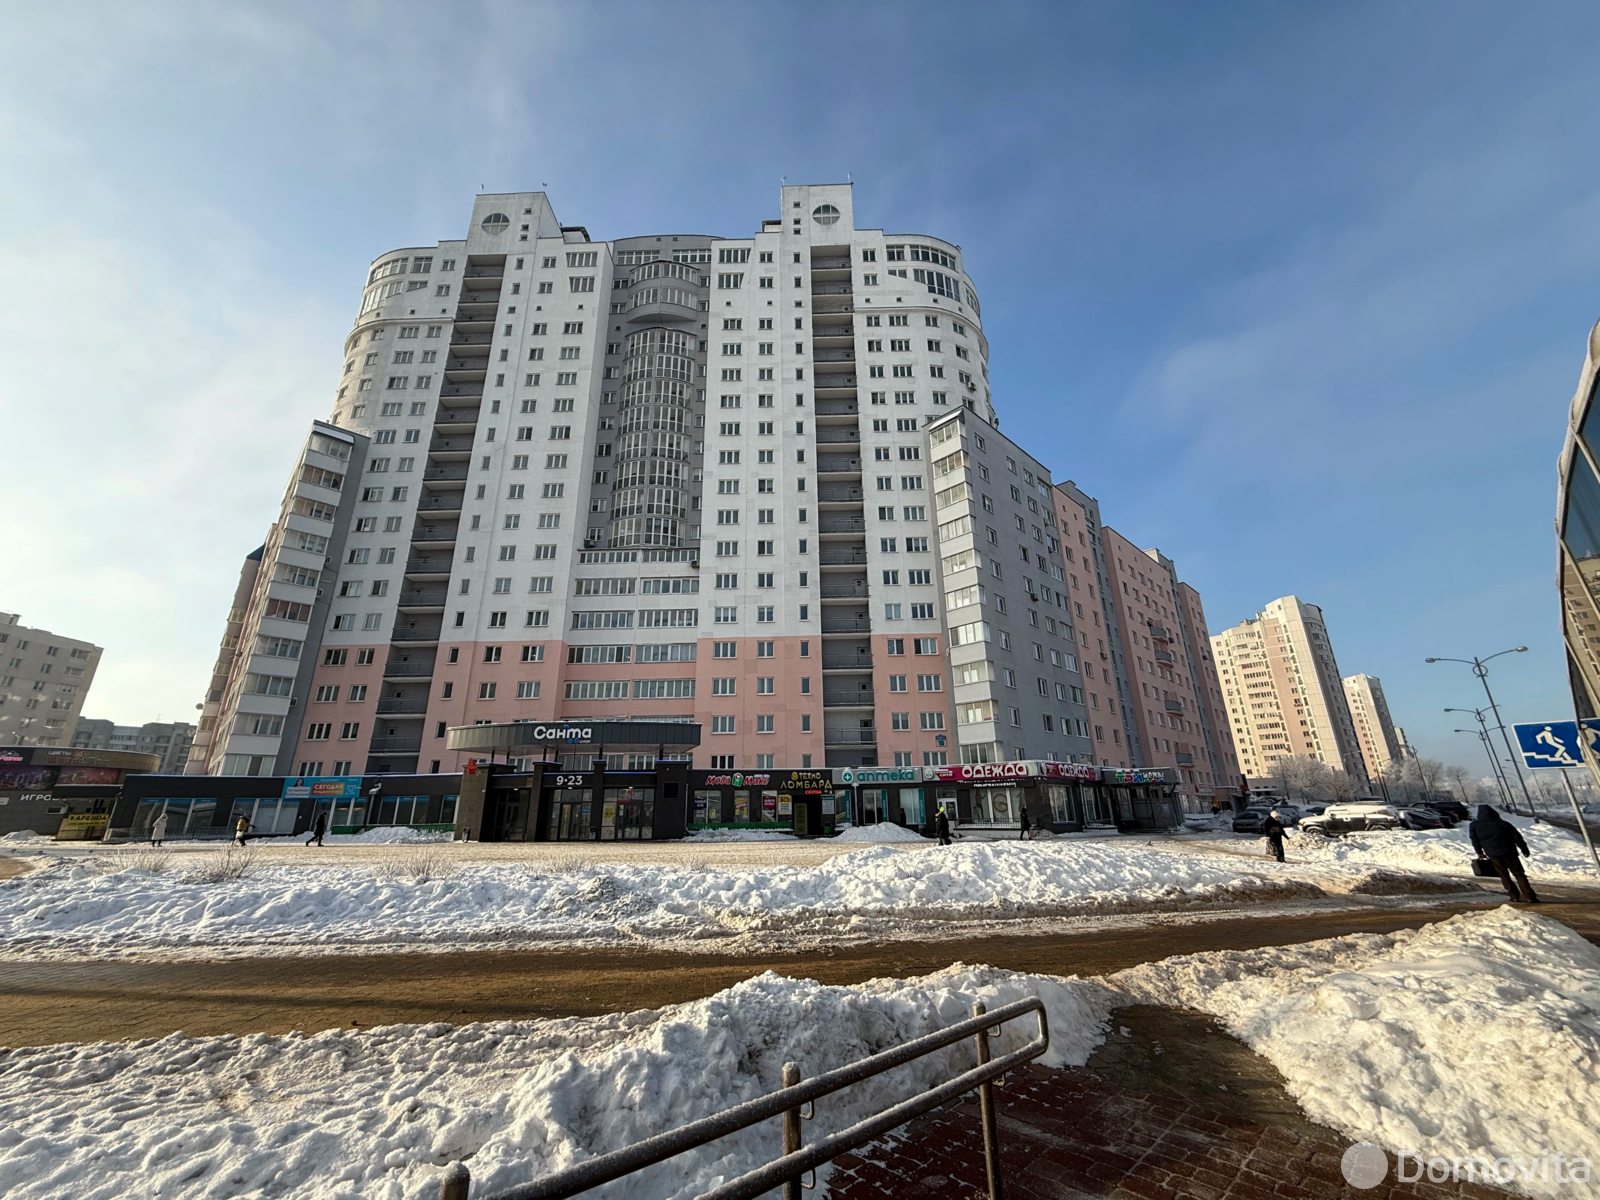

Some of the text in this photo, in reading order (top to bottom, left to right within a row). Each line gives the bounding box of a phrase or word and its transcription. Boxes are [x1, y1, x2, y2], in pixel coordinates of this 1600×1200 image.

[534, 725, 592, 739] Санта
[799, 772, 821, 780] ТЕХНО
[857, 769, 914, 781] аптека
[962, 764, 1027, 778] ОДЕЖДА
[705, 775, 732, 786] Мода
[780, 780, 832, 789] ЛОМБАРД
